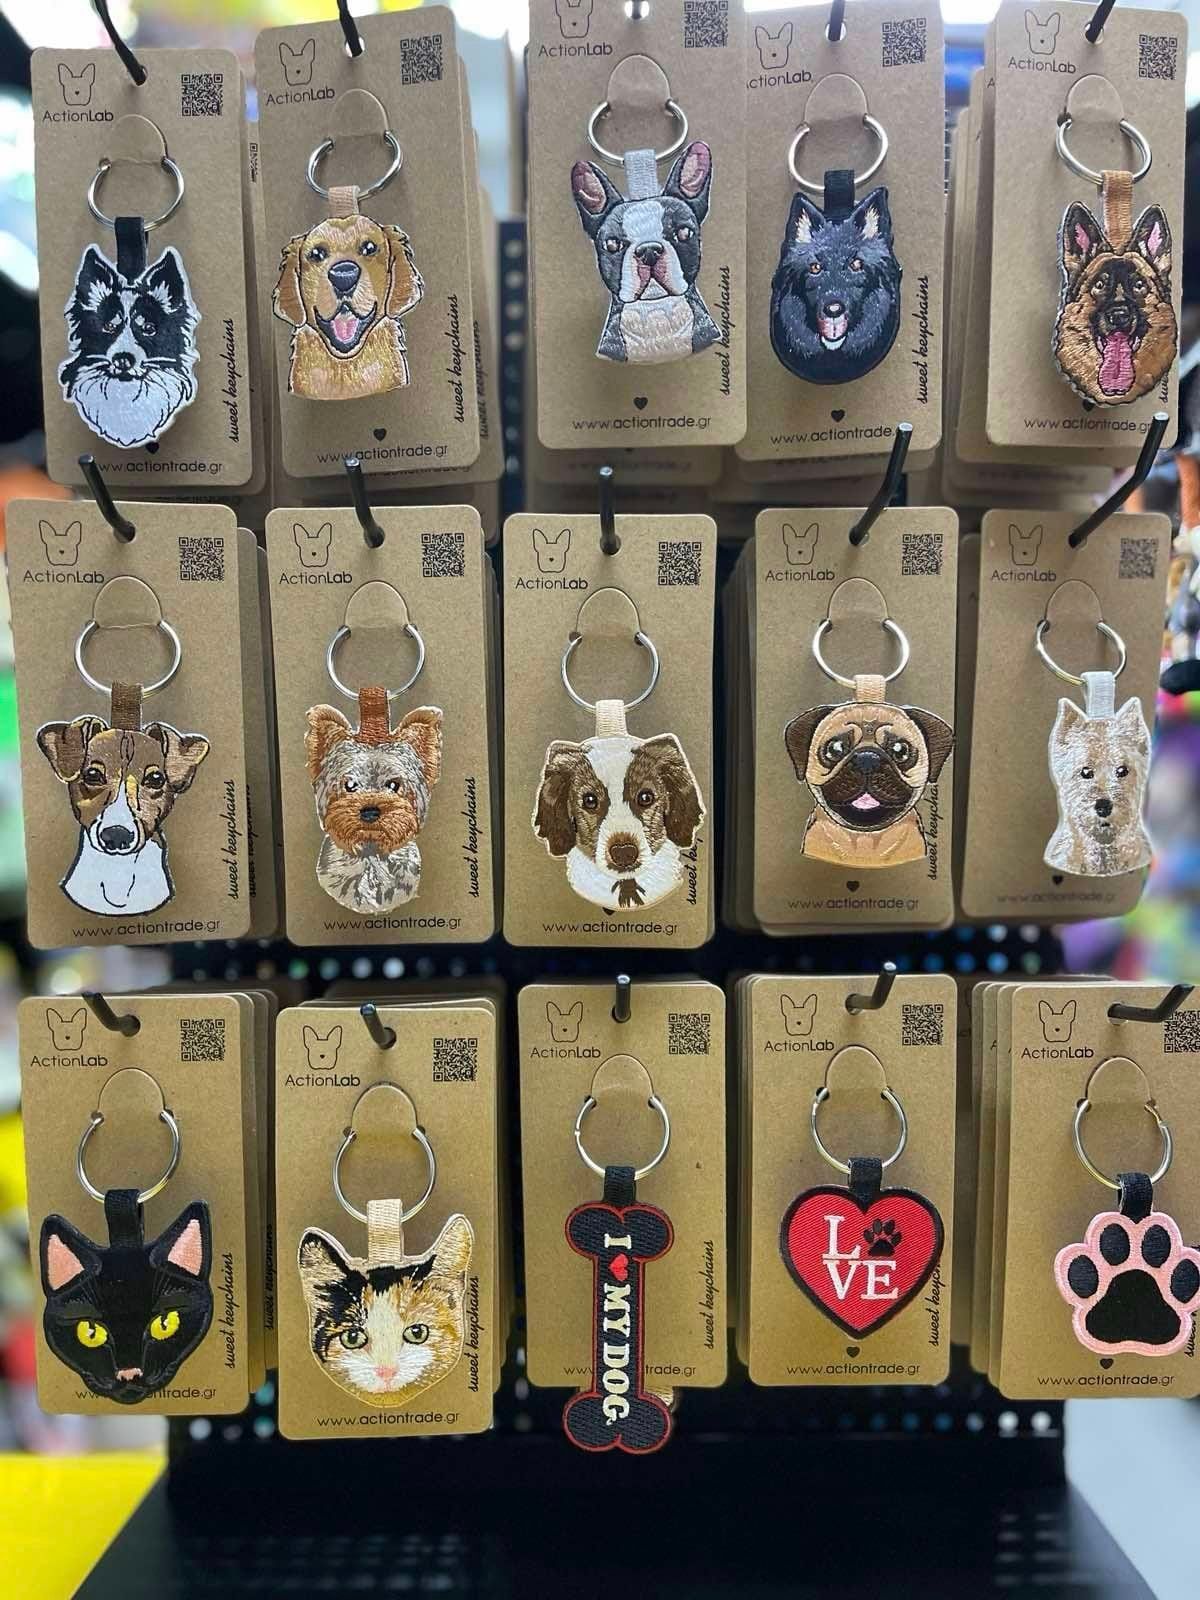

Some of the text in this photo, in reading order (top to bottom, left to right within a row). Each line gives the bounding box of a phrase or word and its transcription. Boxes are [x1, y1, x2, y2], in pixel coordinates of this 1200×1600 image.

[538, 43, 613, 57] ActionLab
[1007, 57, 1077, 74] ActionLab
[746, 69, 812, 89] ctionLab
[265, 87, 336, 106] ActionLab
[42, 109, 114, 123] ActionLab
[715, 266, 736, 395] sweet keychains
[913, 275, 934, 404] sweet keychains
[445, 294, 466, 423] sweet keychains
[219, 318, 241, 443] sweet keychains
[572, 416, 712, 430] www.actiontrade.gr
[770, 425, 895, 444] www.actiontrade.
[99, 460, 223, 474] ww.actiontrade.gr
[23, 569, 105, 585] ActionLab
[279, 570, 353, 585] ActionLab
[766, 568, 836, 582] ActionLab
[991, 568, 1057, 583] ActionLab
[515, 577, 589, 591] ActionLab
[219, 779, 243, 900] sweet keychains
[460, 777, 483, 898] sweet keychains
[926, 841, 937, 880] sweet
[684, 864, 697, 905] sweet
[788, 897, 919, 911] www.actiontrade.gr
[72, 919, 221, 938] www.actiontrade.gr
[324, 916, 462, 930] www.actiontrade.gr
[542, 920, 678, 935] www.actiontrade.gr
[530, 1045, 601, 1059] ActionLab
[764, 1037, 835, 1052] ActionLab
[30, 1054, 108, 1068] ActionLab
[1021, 1046, 1095, 1060] ActionLab
[285, 1072, 361, 1088] ActionLab
[699, 1239, 720, 1349] sweet keychains
[218, 1252, 240, 1368] sweet keychains
[464, 1276, 485, 1392] sweet keychains
[602, 1233, 632, 1426] I MY DOG
[925, 1308, 939, 1347] sweet
[787, 1362, 921, 1376] www.actiontrade.gr
[1037, 1373, 1176, 1387] www.actiontrade.gr
[317, 1410, 460, 1428] www.actiontrade.gr
